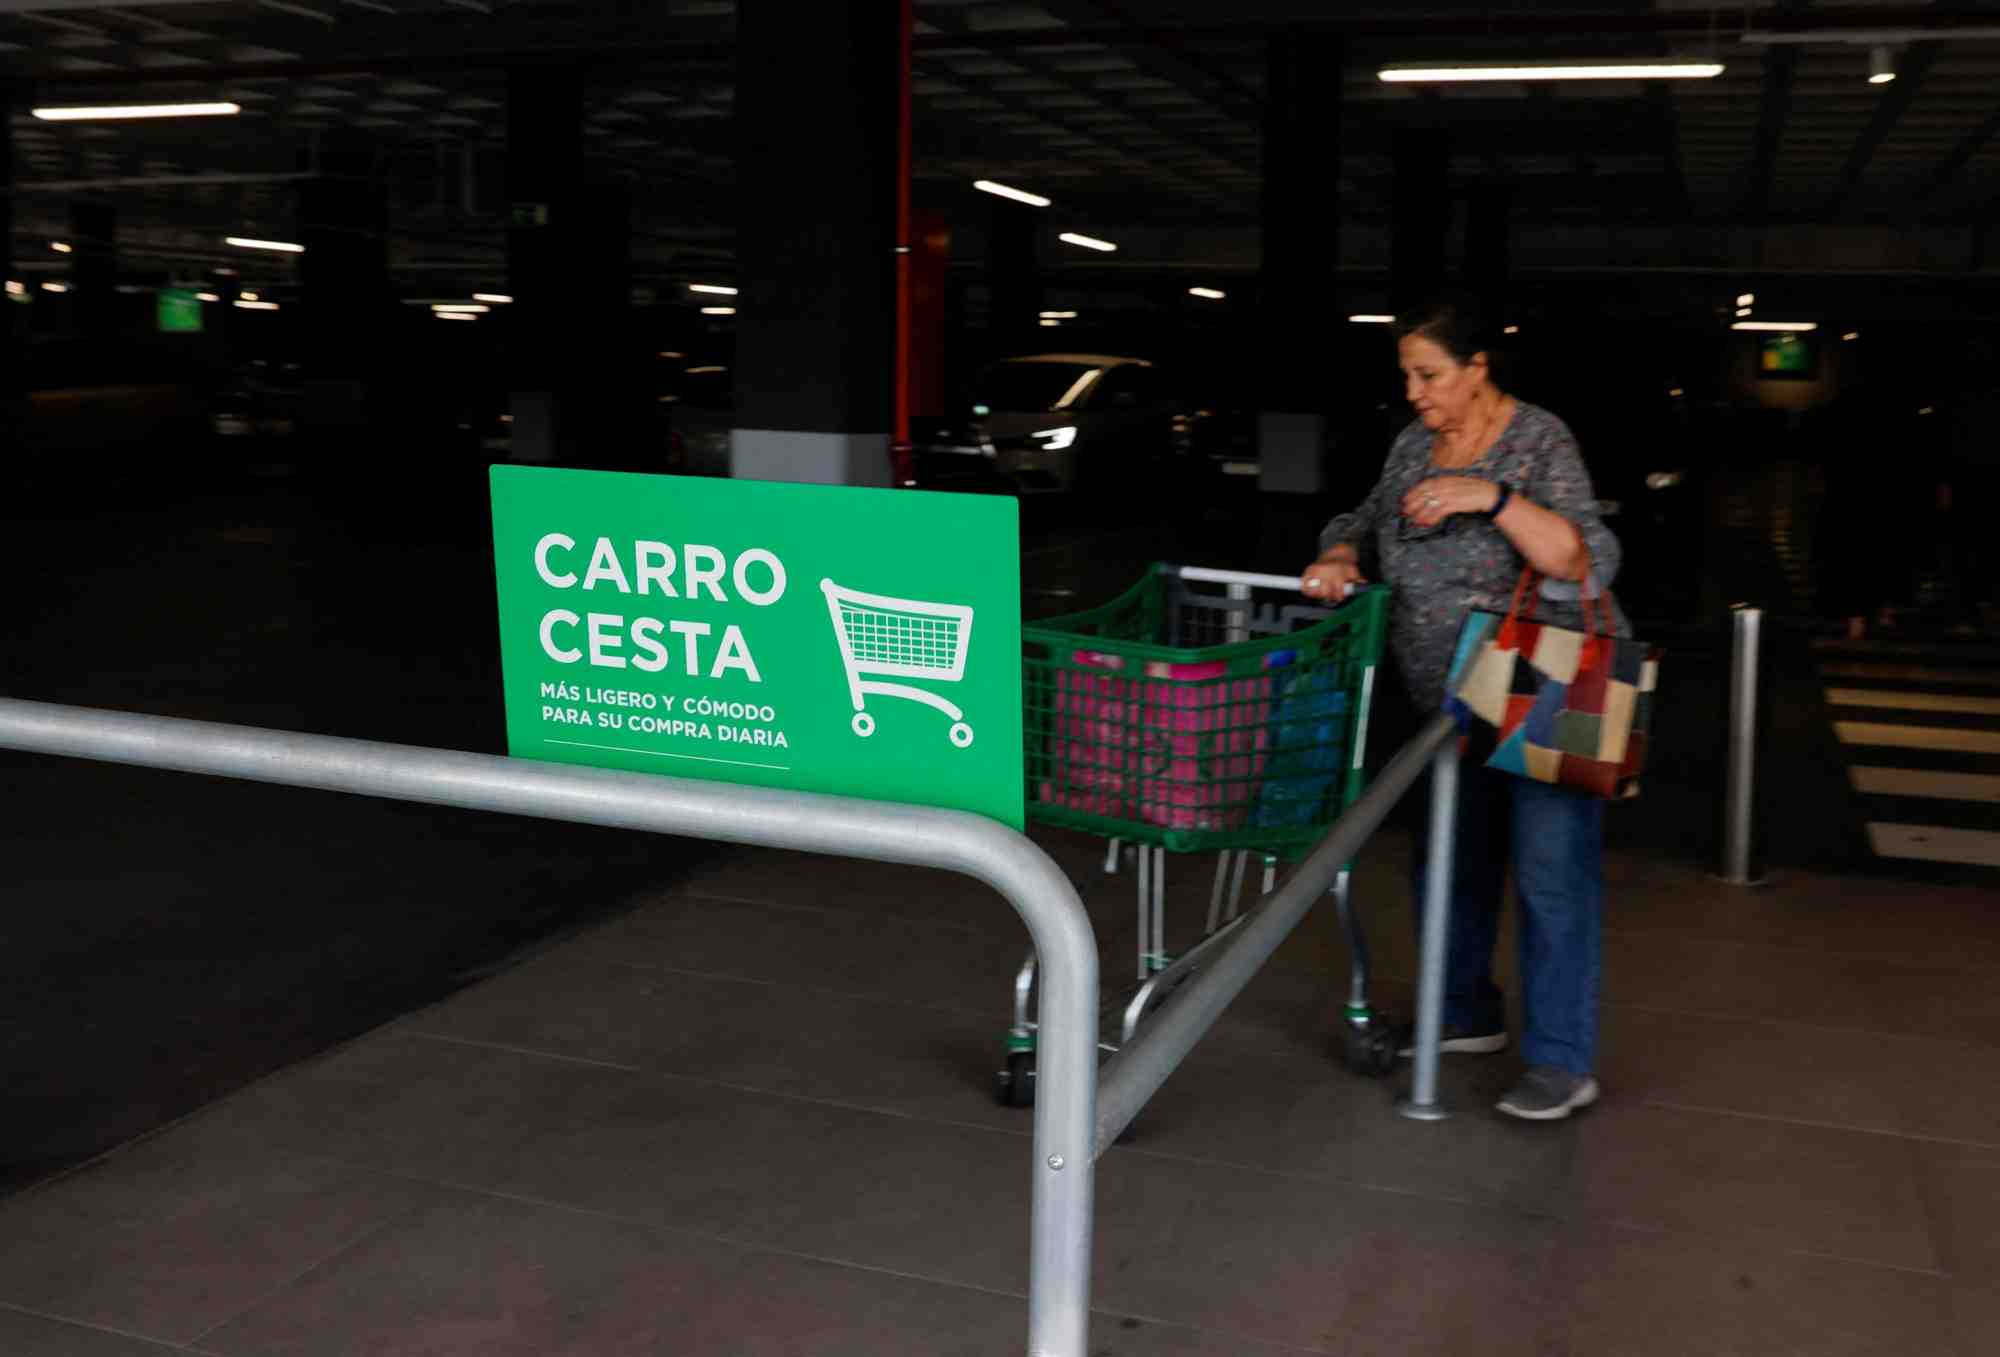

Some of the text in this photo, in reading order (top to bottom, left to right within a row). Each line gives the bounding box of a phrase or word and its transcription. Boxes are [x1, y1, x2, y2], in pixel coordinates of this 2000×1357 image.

[534, 533, 787, 606] CARRO
[539, 609, 761, 682] CESTA
[541, 681, 775, 722] MÁS LIGERO Y CÓMODO
[542, 706, 789, 748] PARA SU COMPRA DIARIA
